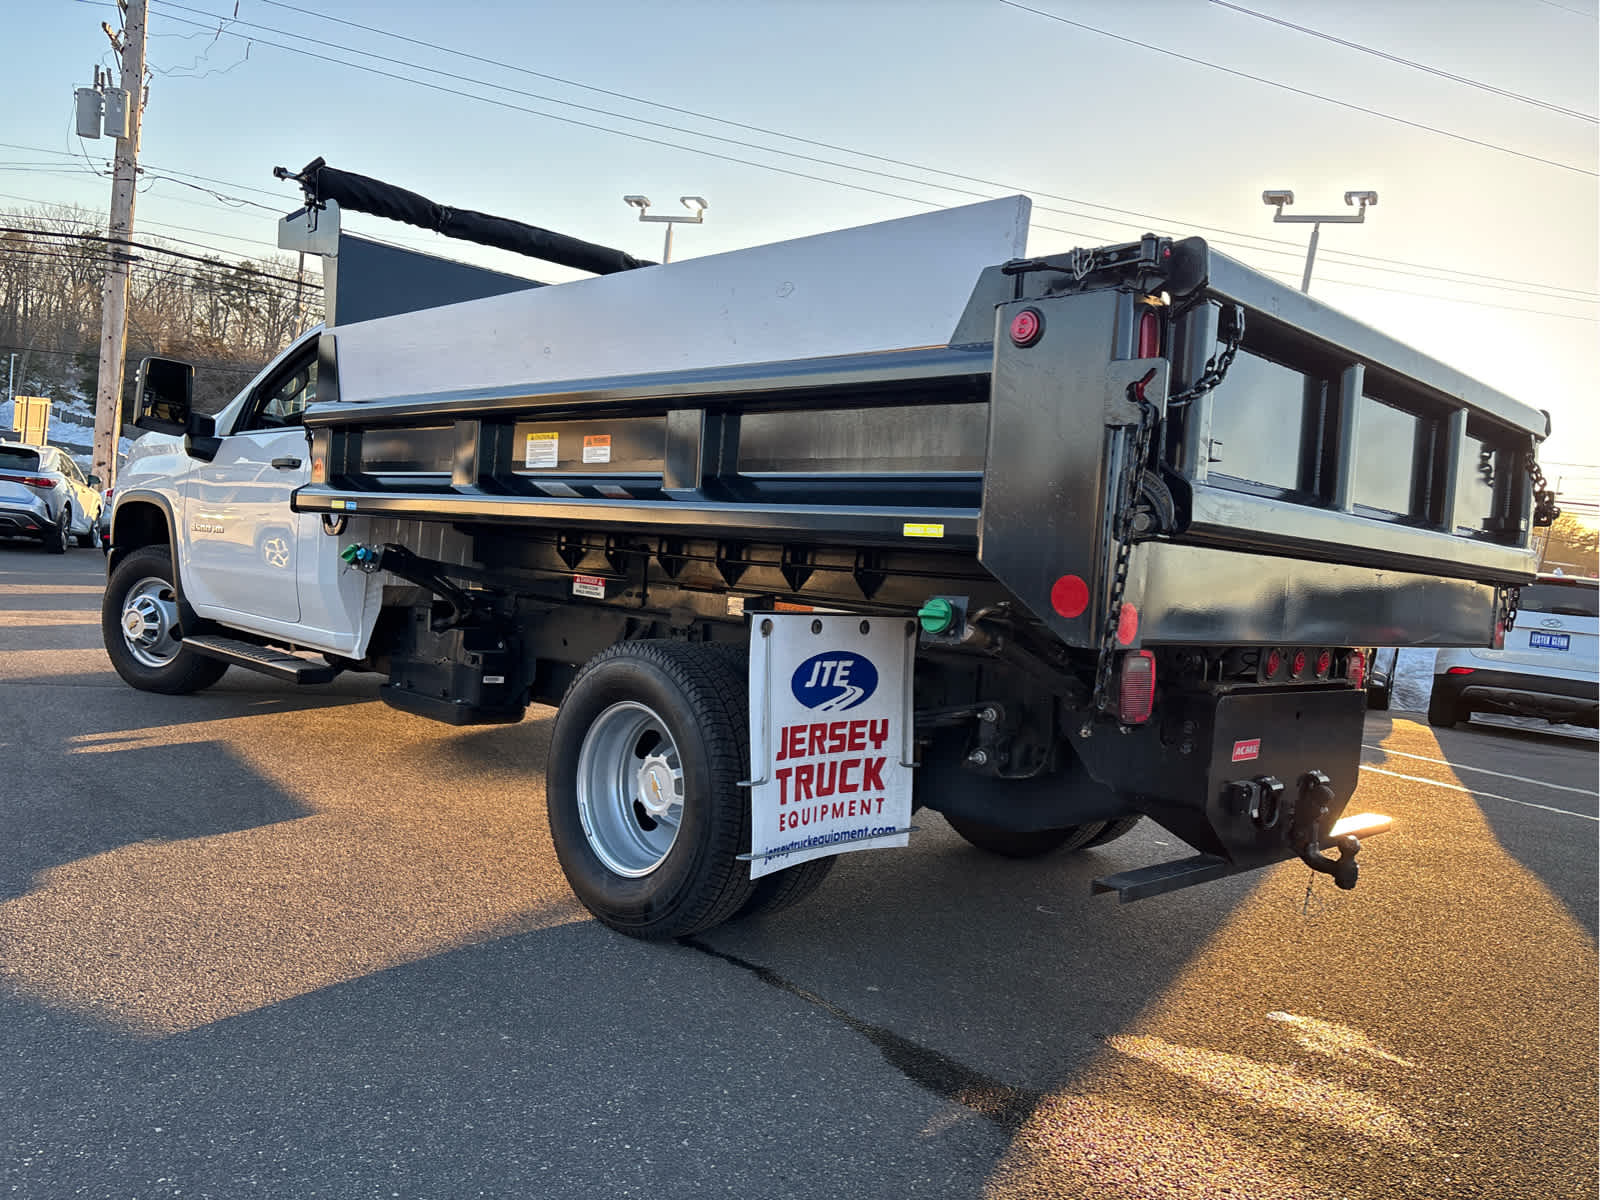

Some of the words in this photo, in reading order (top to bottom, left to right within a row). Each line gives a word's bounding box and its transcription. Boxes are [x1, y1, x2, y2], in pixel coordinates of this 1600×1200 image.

[805, 660, 854, 688] JTE
[776, 719, 889, 761] JERSEY
[1236, 744, 1258, 755] ACME
[775, 757, 887, 805] TRUCK
[779, 798, 885, 831] EQUIPMENT
